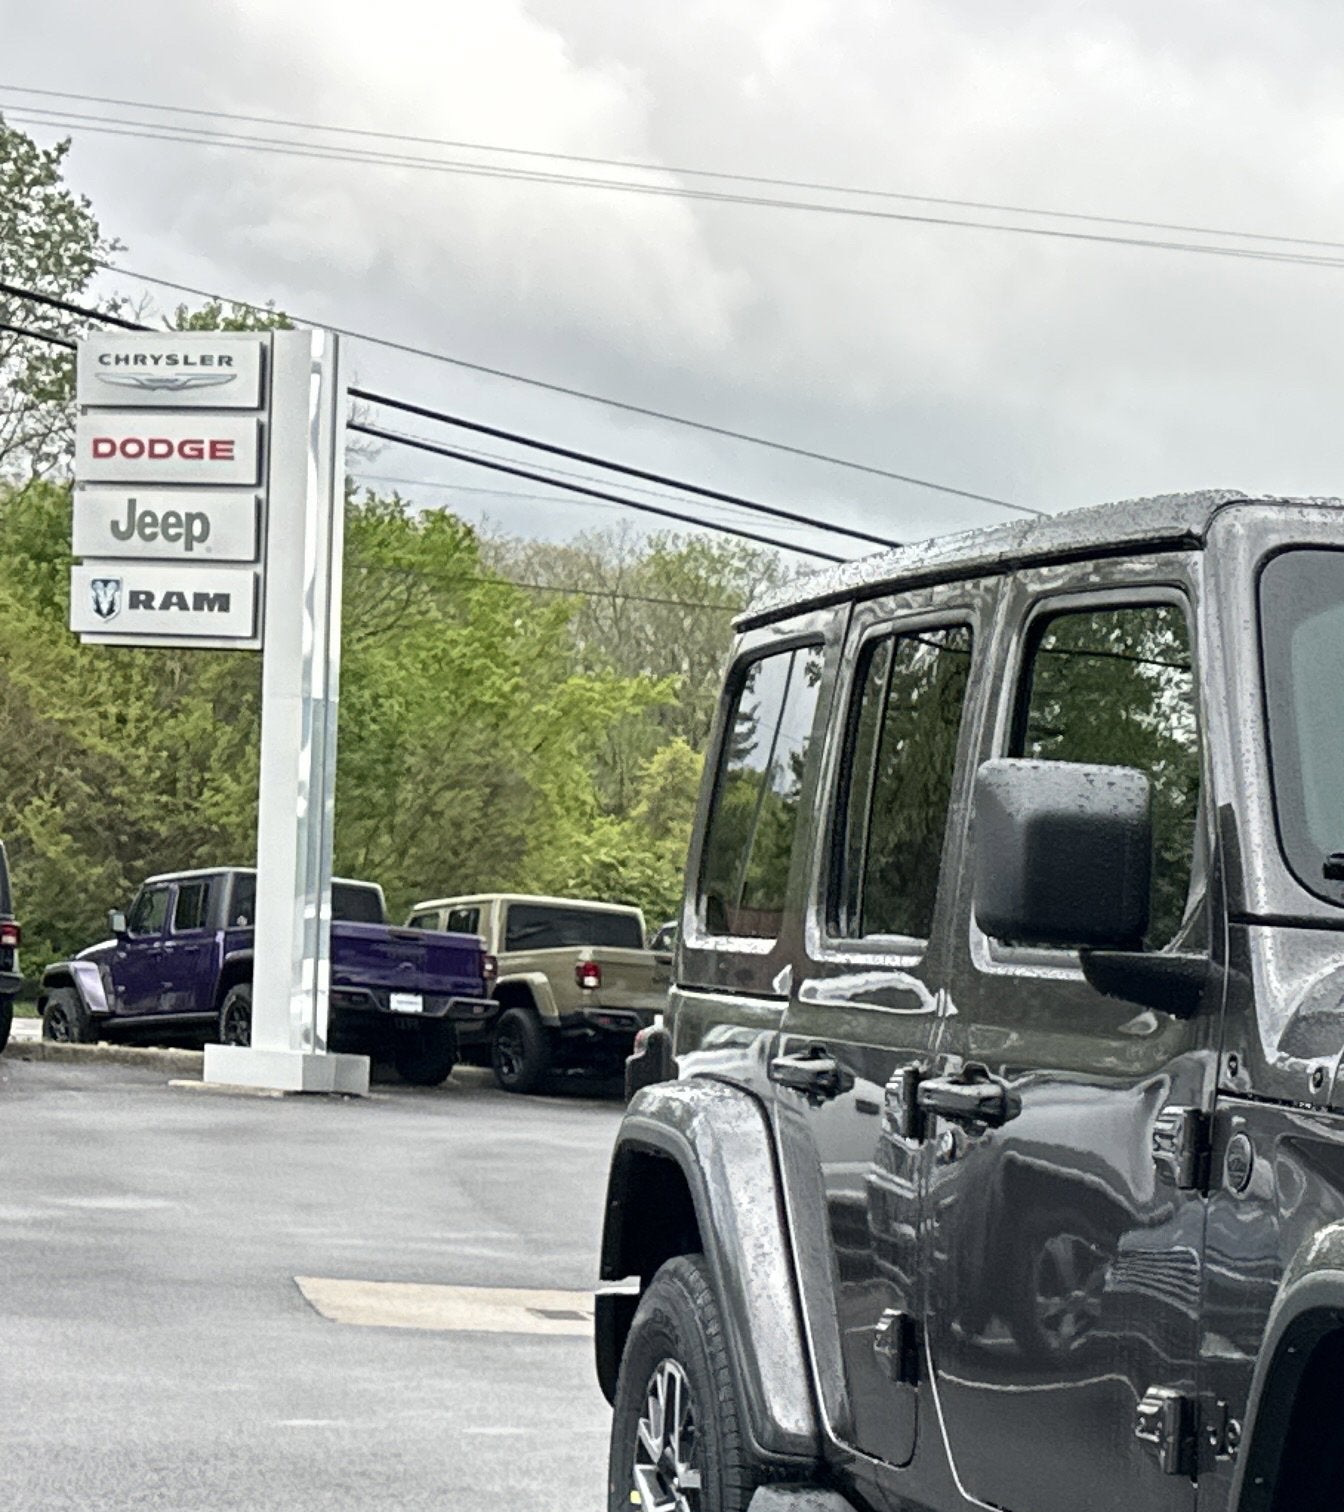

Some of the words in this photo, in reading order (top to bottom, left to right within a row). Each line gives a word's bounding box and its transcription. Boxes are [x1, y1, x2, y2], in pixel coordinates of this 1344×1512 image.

[98, 353, 234, 367] CHRYSLER
[92, 437, 235, 461] DODGE
[110, 498, 211, 551] Jeep
[128, 590, 230, 612] RAM
